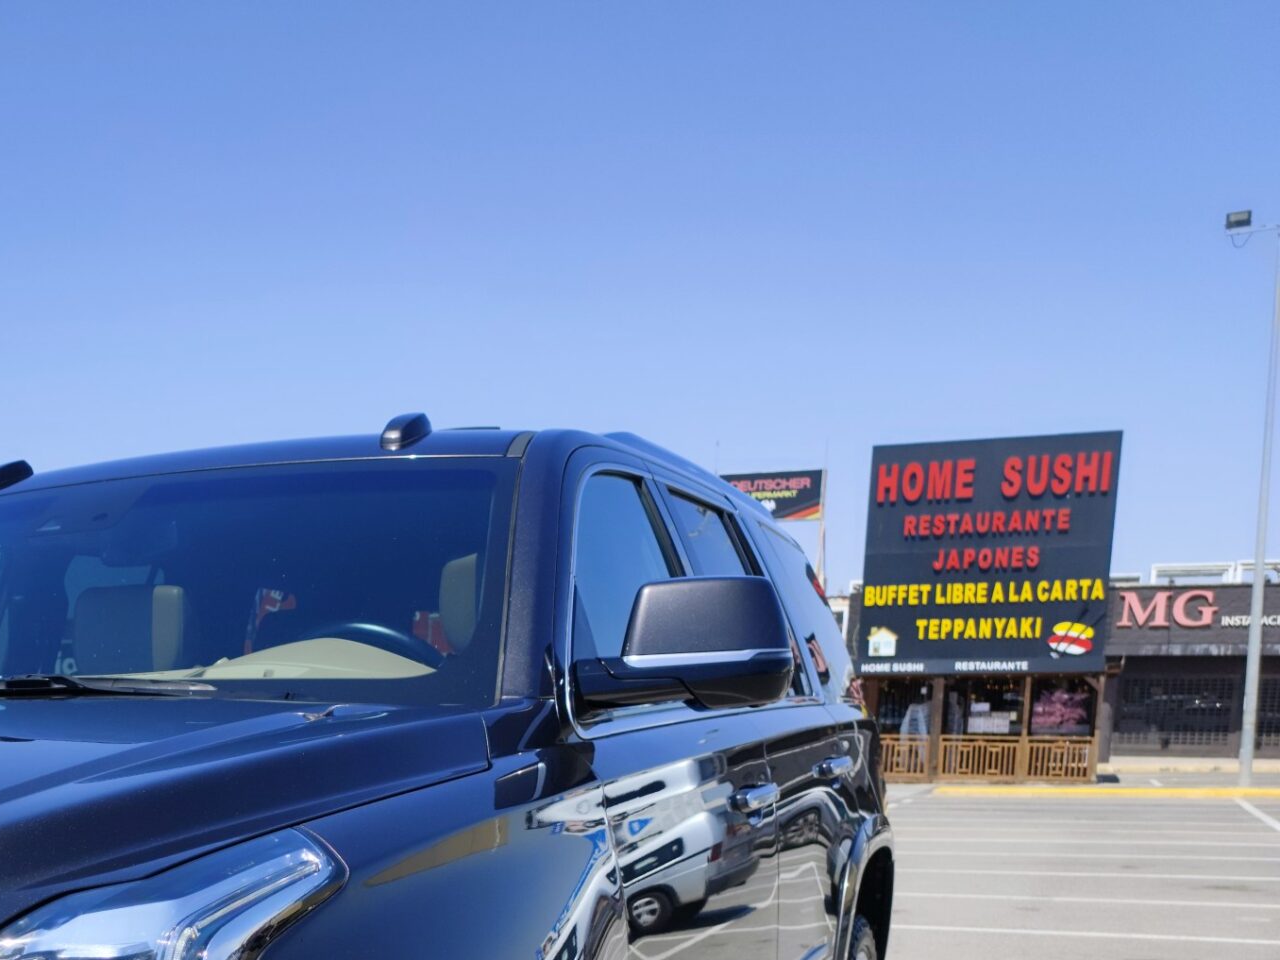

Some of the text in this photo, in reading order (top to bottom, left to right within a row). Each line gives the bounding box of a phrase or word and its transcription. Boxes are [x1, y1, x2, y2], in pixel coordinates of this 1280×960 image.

[729, 477, 811, 492] DEUTSCHER
[876, 451, 1114, 504] HOME SUSHI
[903, 508, 1071, 537] RESTAURANTE
[932, 546, 1040, 571] JAPONES
[864, 578, 1105, 606] BUFFET LIBRE A LA CARTA
[1116, 589, 1219, 628] MG
[916, 617, 1042, 640] TEPPANYAKI
[861, 662, 924, 673] HOME SUSHI
[955, 660, 1028, 671] RESTAURANTE
